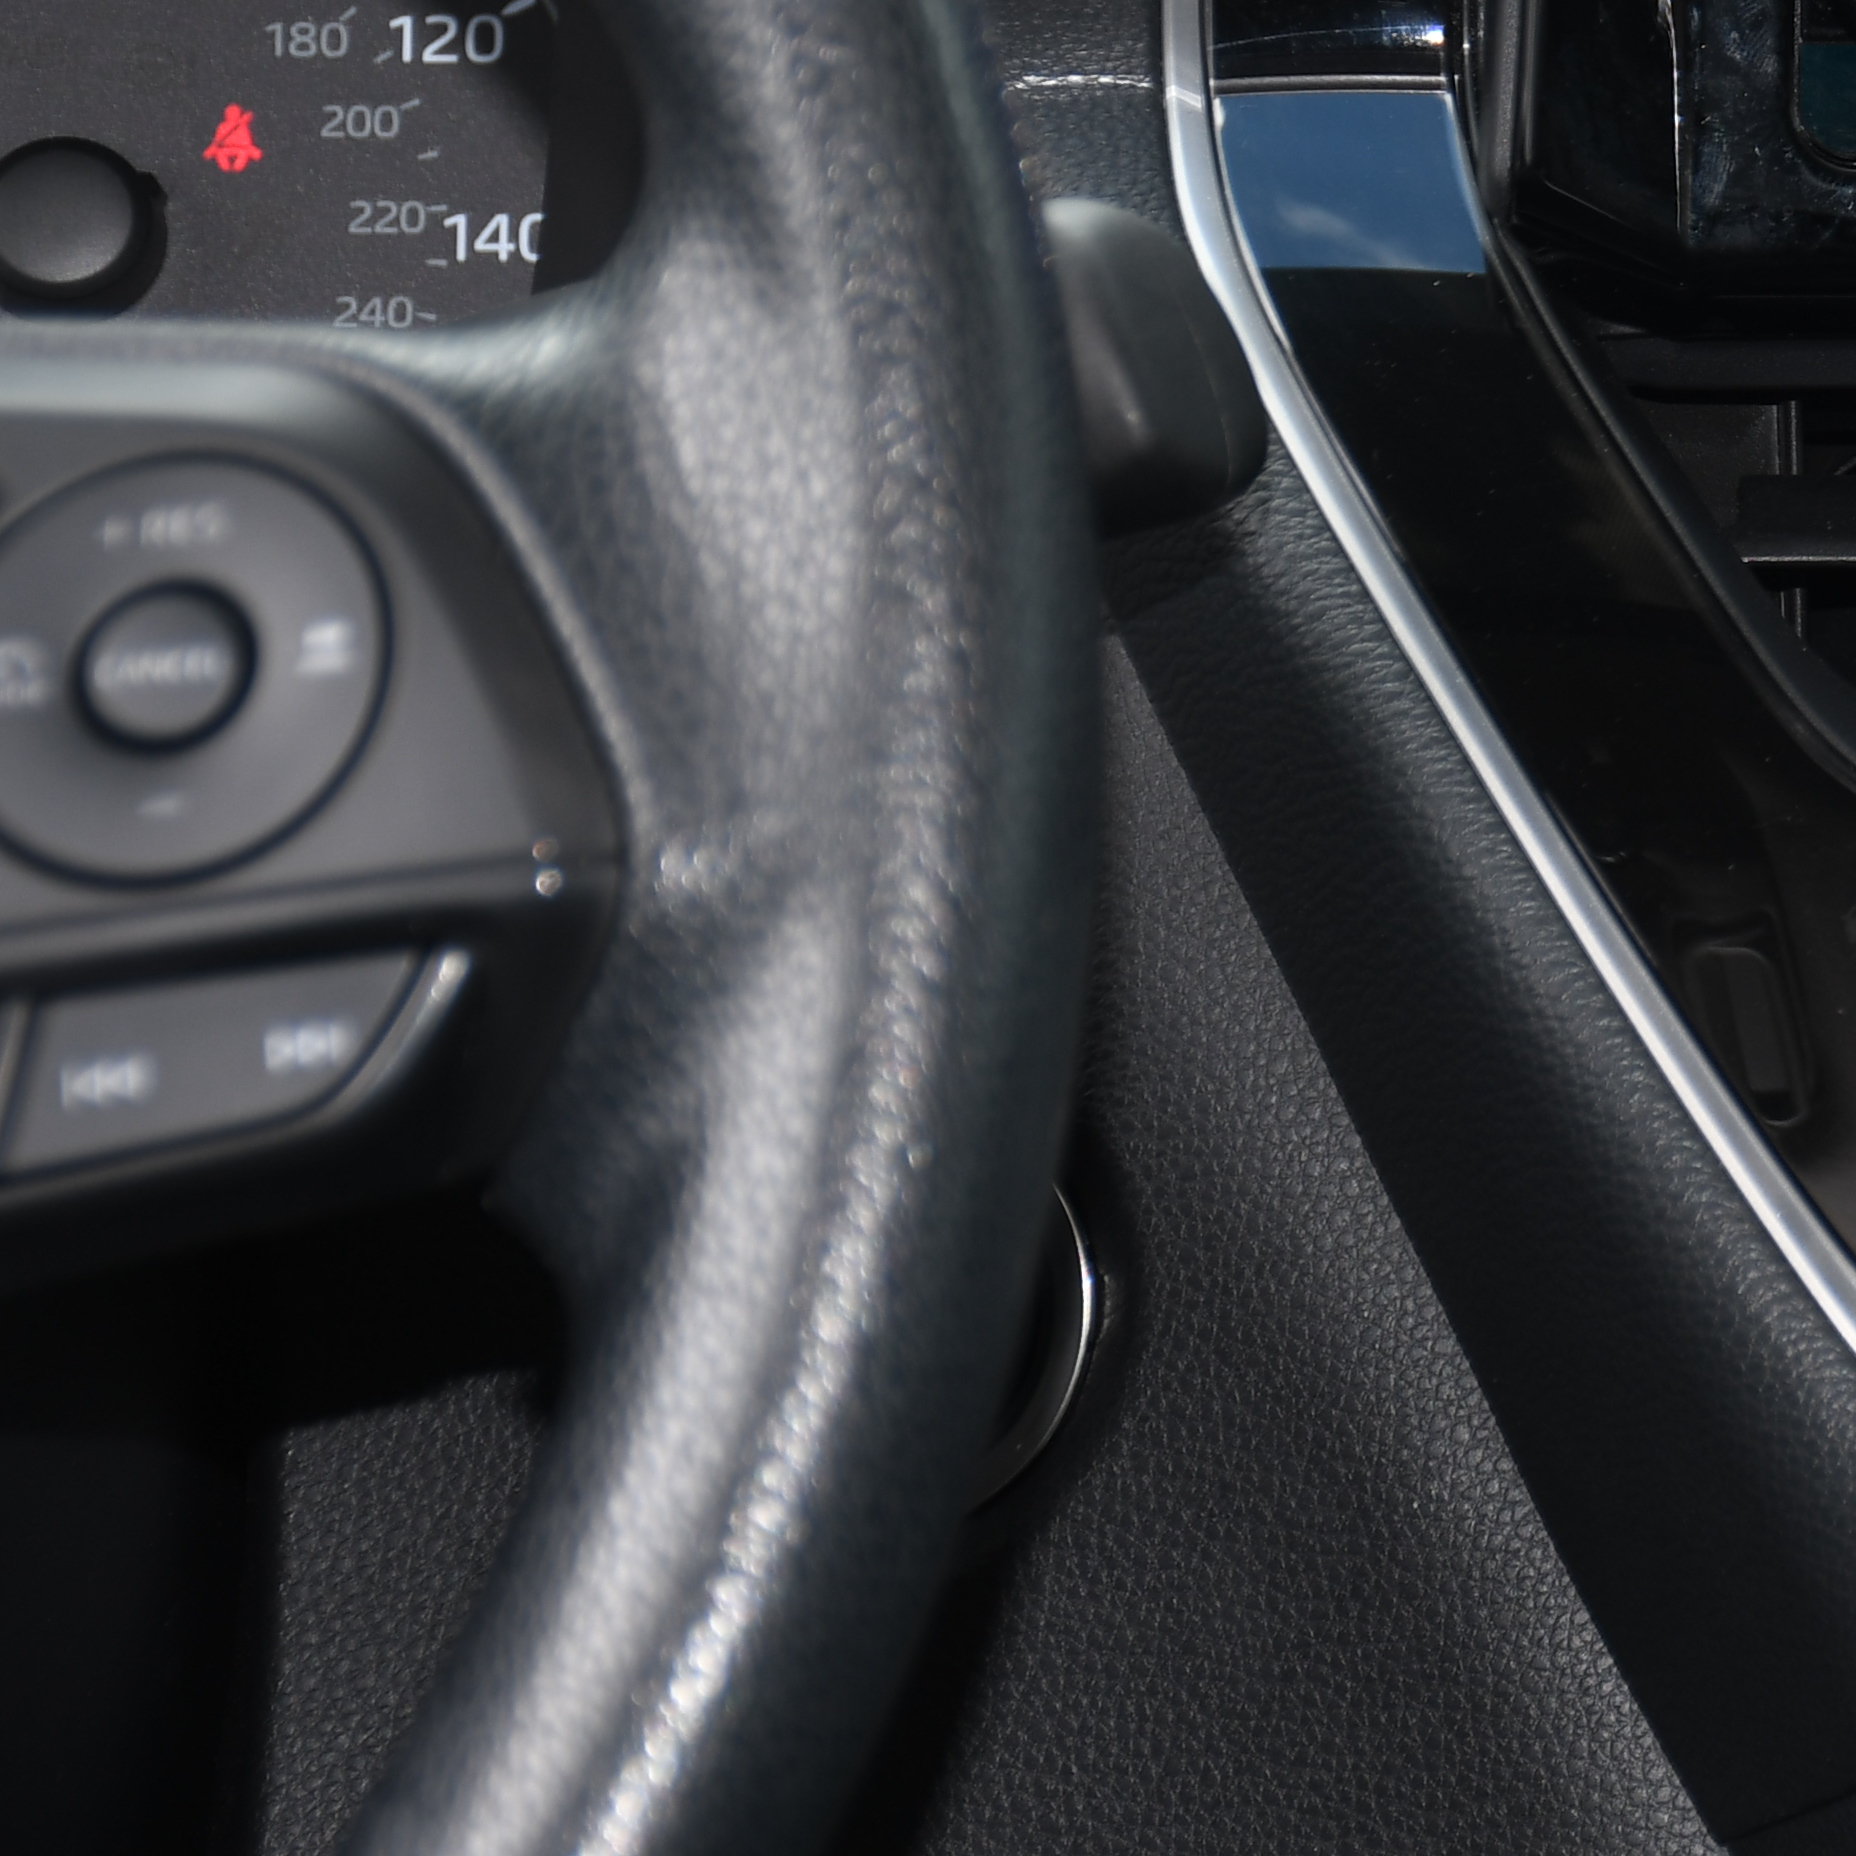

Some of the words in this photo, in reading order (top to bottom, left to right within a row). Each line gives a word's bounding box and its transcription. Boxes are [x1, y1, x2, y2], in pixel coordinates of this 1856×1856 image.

[265, 20, 349, 58] 180
[388, 13, 503, 64] 120
[320, 104, 399, 138] 200
[348, 200, 425, 234] 220
[333, 296, 413, 328] 240
